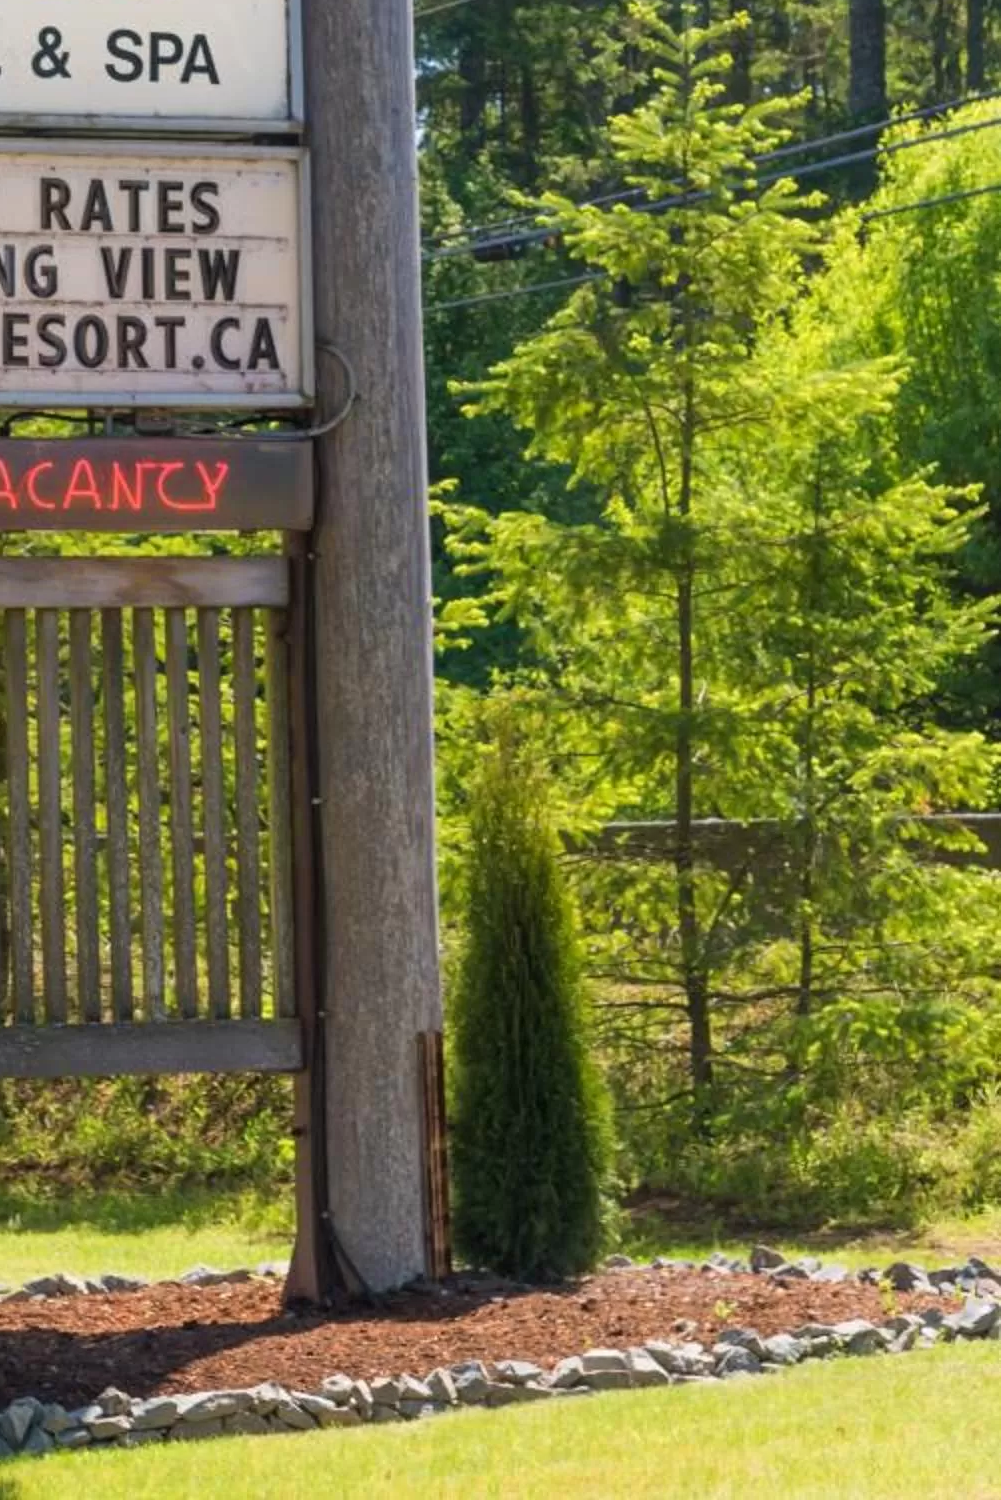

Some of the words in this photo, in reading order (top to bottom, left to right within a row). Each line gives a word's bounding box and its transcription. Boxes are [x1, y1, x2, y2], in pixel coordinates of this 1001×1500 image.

[30, 26, 72, 79] &
[104, 28, 221, 85] SPA
[40, 176, 221, 234] RATES
[102, 246, 241, 301] VIEW
